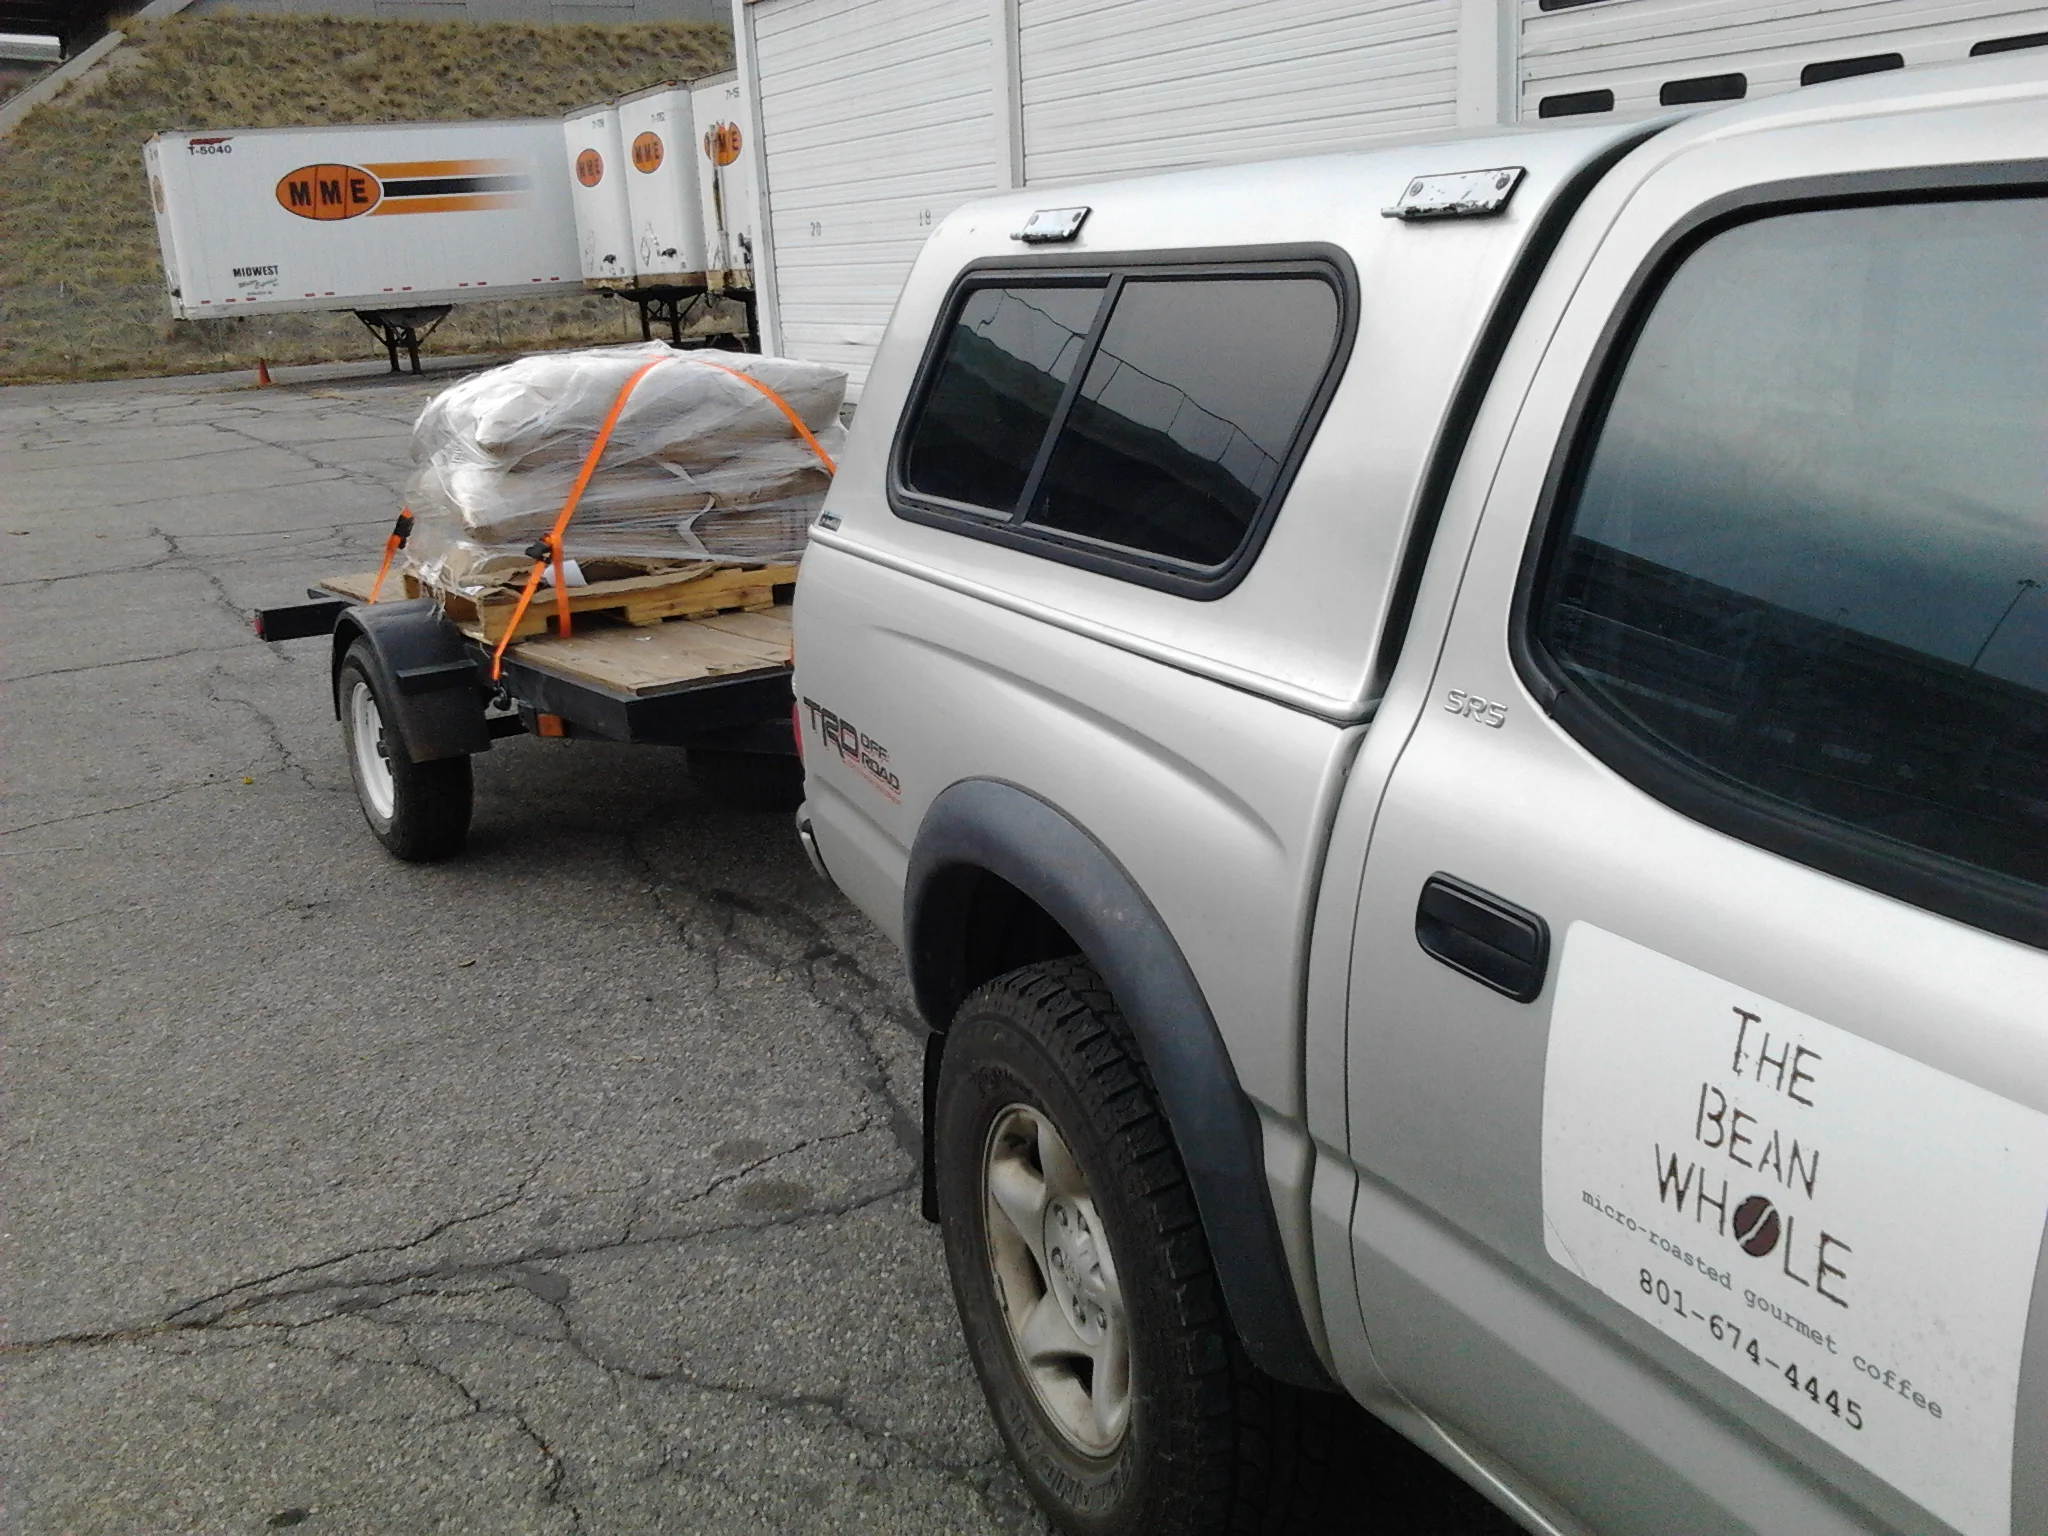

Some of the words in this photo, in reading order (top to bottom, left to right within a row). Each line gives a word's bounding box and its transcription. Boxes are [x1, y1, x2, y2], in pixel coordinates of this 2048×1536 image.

[187, 145, 233, 156] T-5040
[288, 178, 369, 207] MME
[232, 264, 279, 278] MIDWEST
[803, 696, 860, 761] TRD
[1443, 687, 1509, 729] SRS
[860, 732, 889, 760] OFF
[861, 752, 901, 791] ROAD
[1732, 1005, 1823, 1108] THE
[1695, 1081, 1820, 1201] BEAN
[1581, 1189, 1733, 1291] micro-roasted
[1743, 1288, 1839, 1355] gourmet
[1852, 1354, 1944, 1420] coffee
[1639, 1267, 1864, 1431] 801-674-4445
